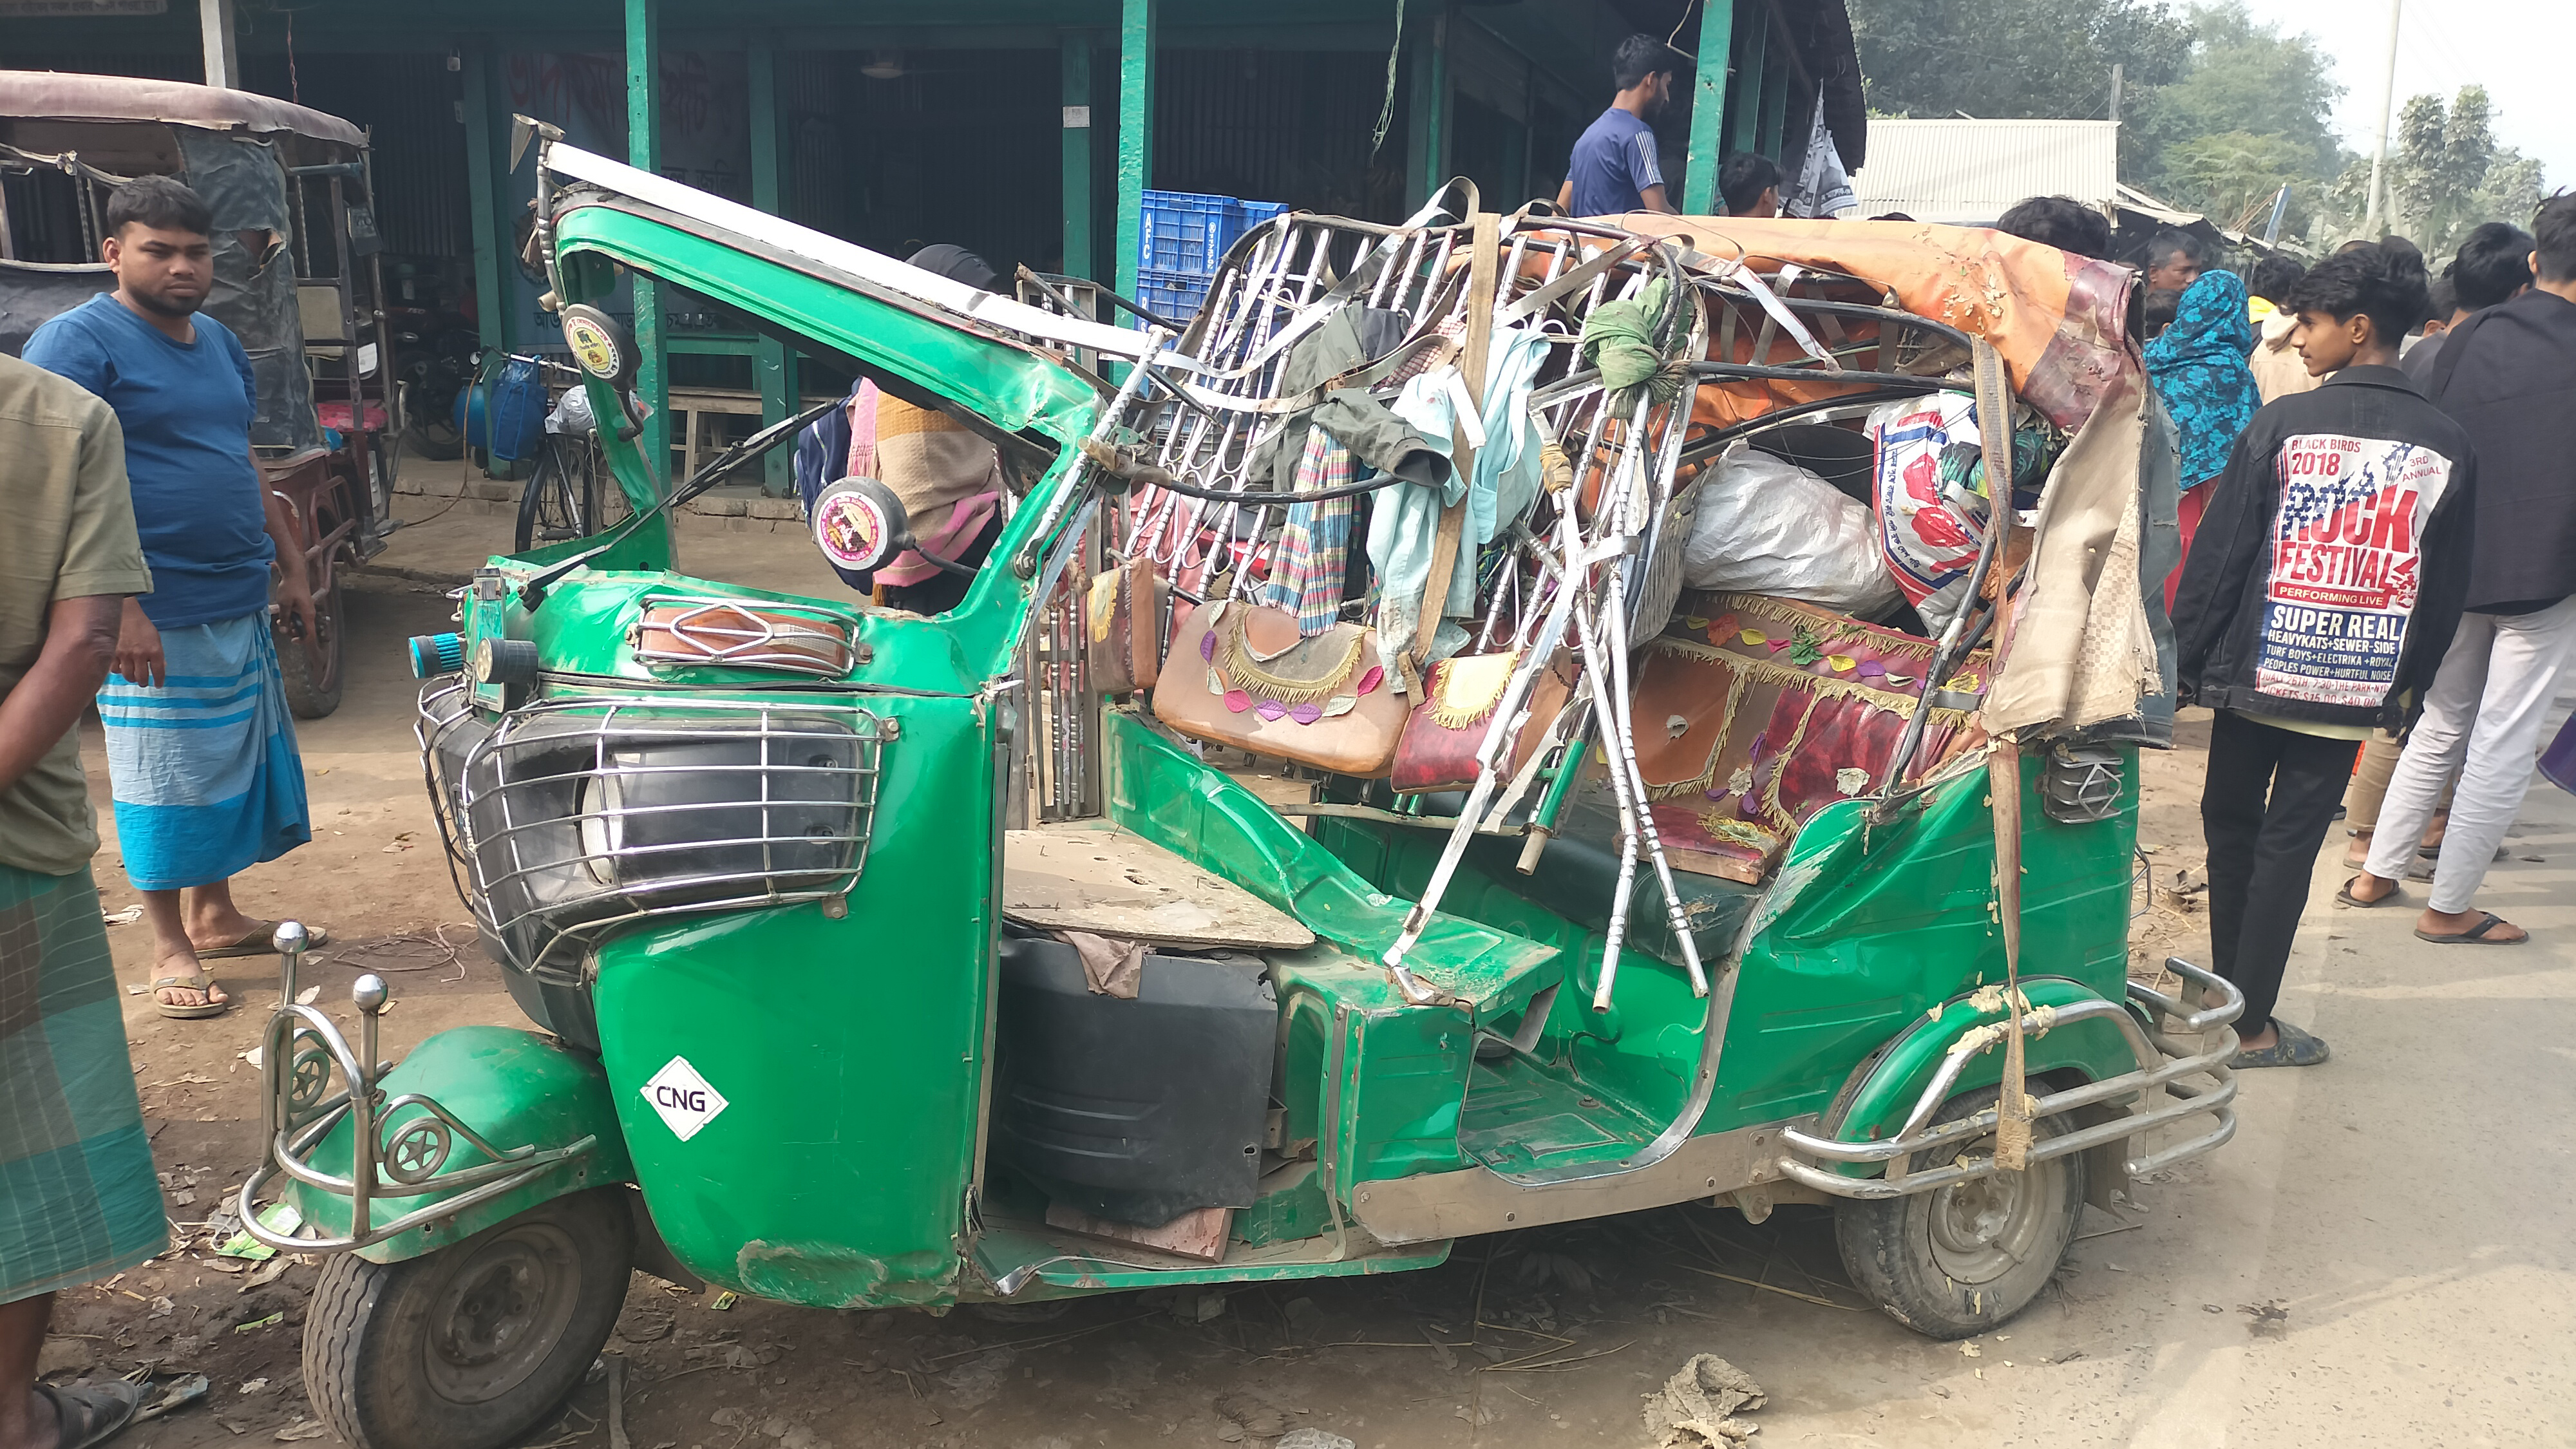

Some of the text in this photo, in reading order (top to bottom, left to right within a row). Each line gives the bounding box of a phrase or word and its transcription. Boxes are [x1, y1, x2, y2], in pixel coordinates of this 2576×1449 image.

[2291, 439, 2362, 453] BLACK BIRDS
[2291, 452, 2341, 476] 2018
[2409, 455, 2429, 467] 3RD
[2402, 466, 2443, 482] ANNUAL
[2280, 480, 2419, 553] ROCK
[2276, 541, 2396, 592] FESTIVAL
[2279, 585, 2384, 605] PERFORMING LIVE
[2271, 605, 2401, 641] SUPER REAL
[2266, 644, 2286, 656] TURF
[2263, 658, 2298, 673] PEOPLES
[2371, 670, 2392, 681] NOISE
[656, 1086, 706, 1113] CNG
